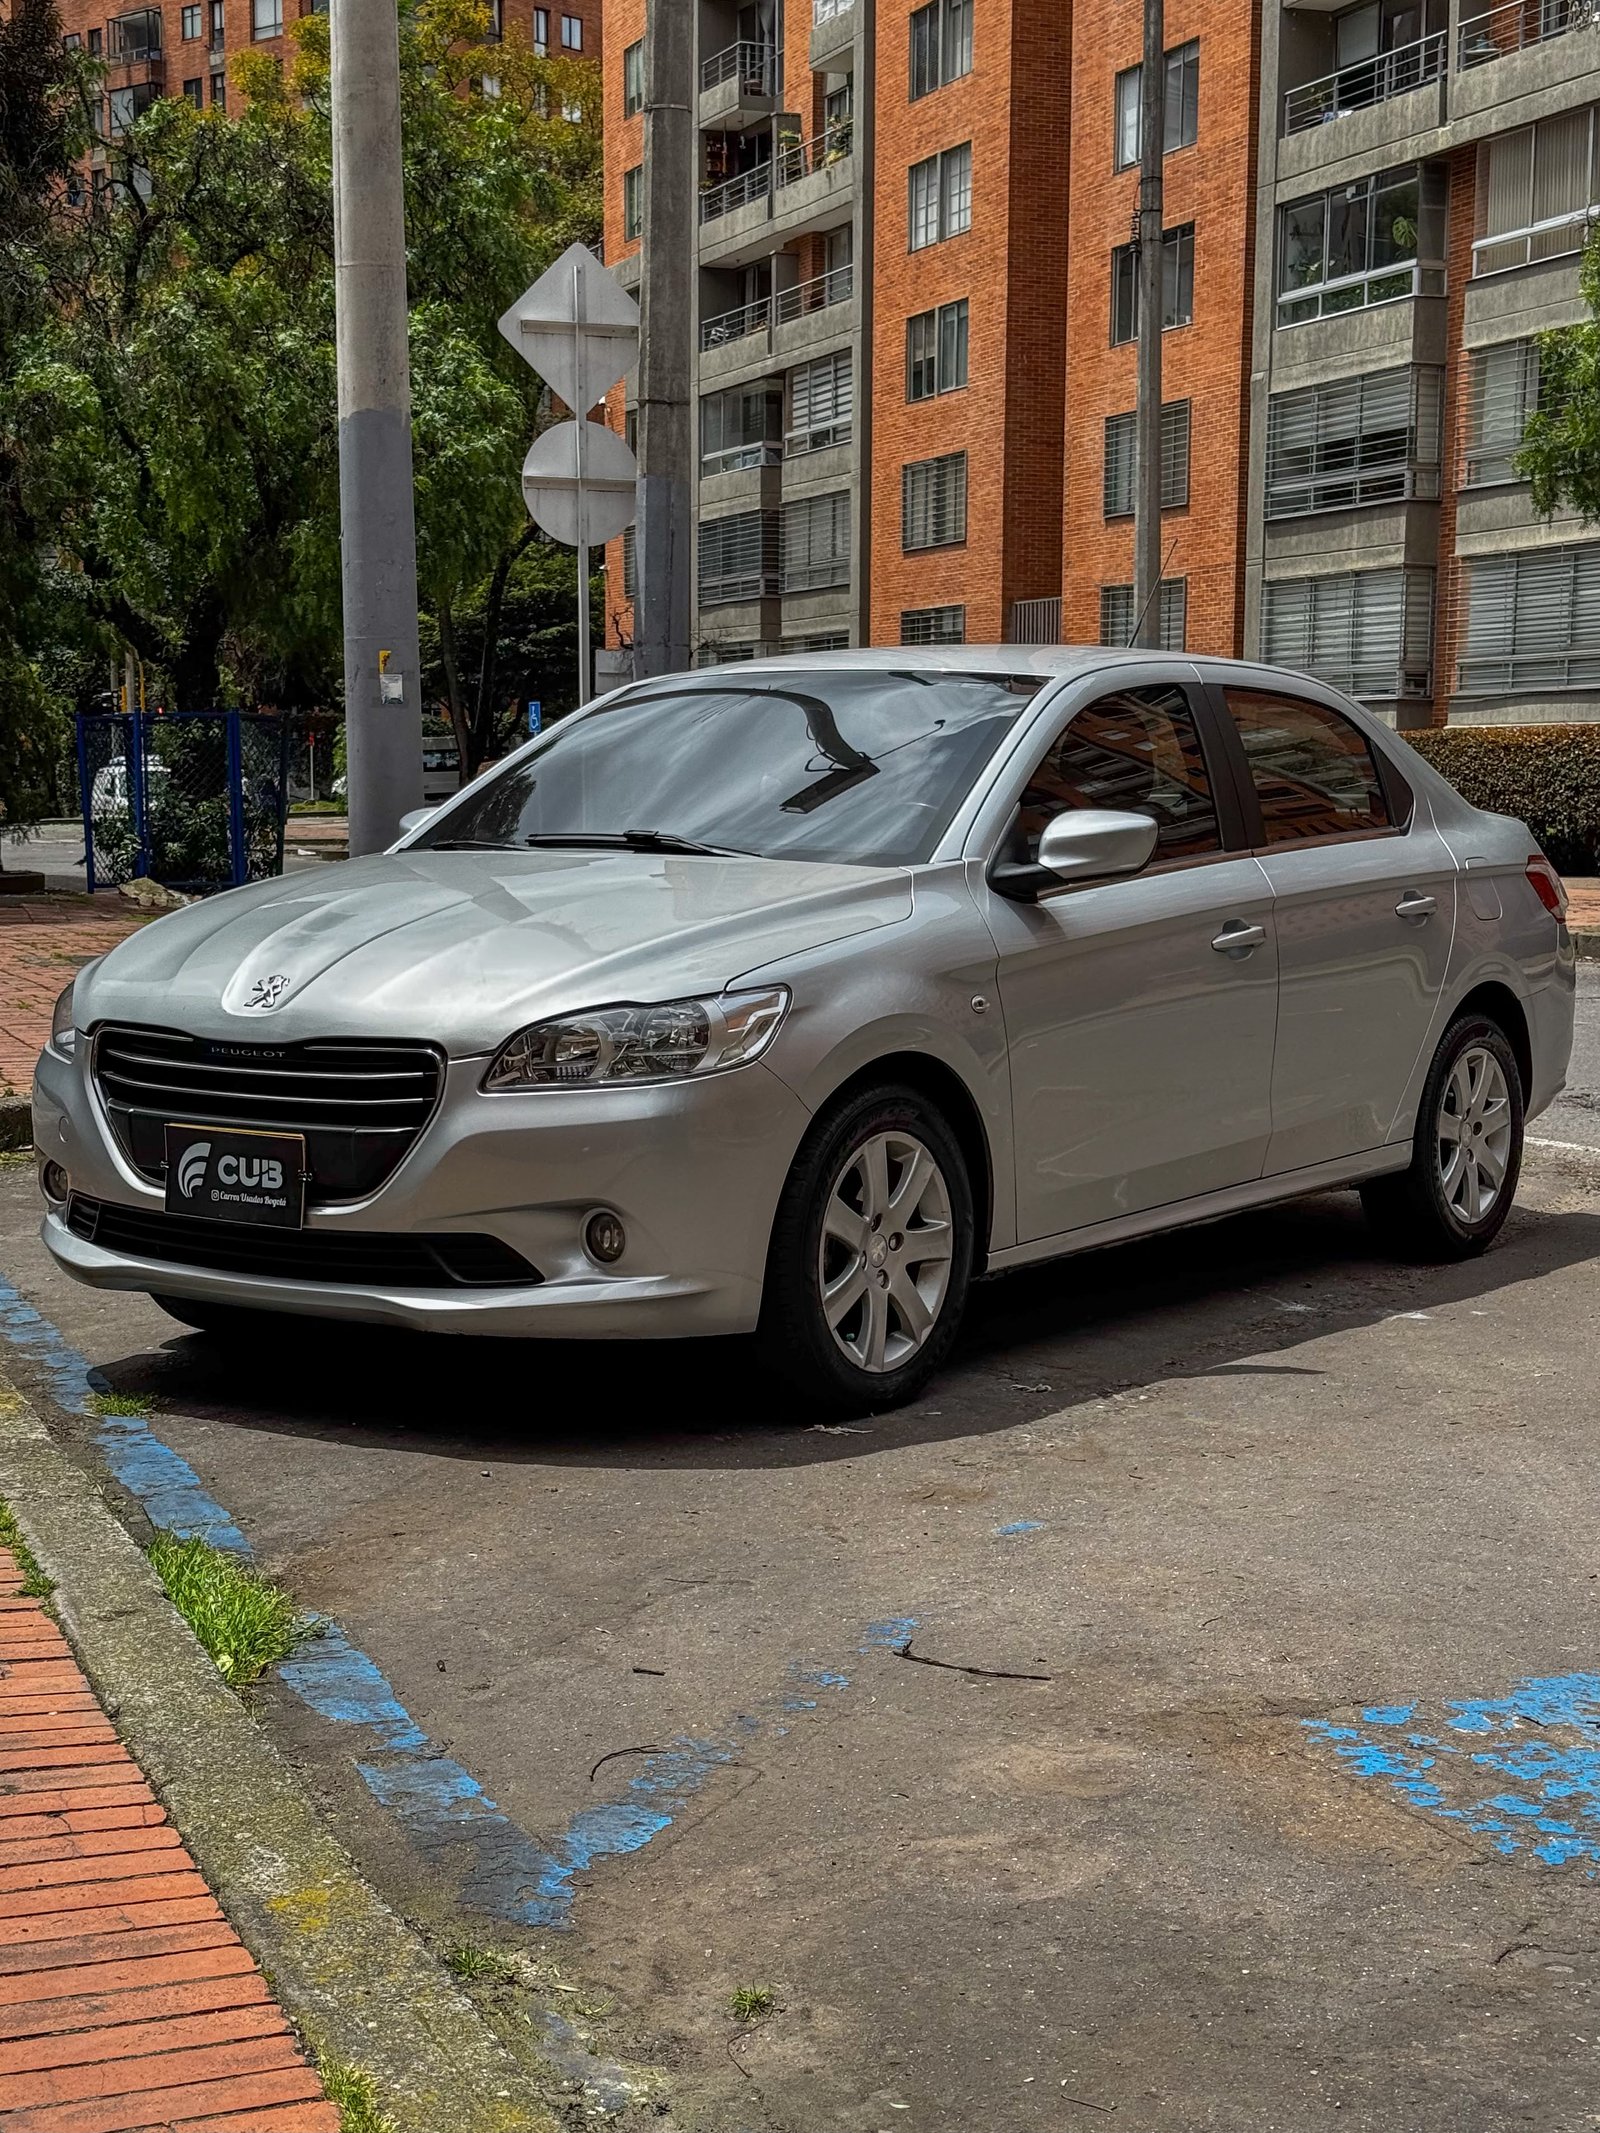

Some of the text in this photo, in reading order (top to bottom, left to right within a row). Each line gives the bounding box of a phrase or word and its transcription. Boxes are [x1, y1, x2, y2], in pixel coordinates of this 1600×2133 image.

[211, 1046, 286, 1058] PEUGEOT
[217, 1154, 283, 1189] CUB
[220, 1190, 287, 1208] Carros Usados Bogotá
